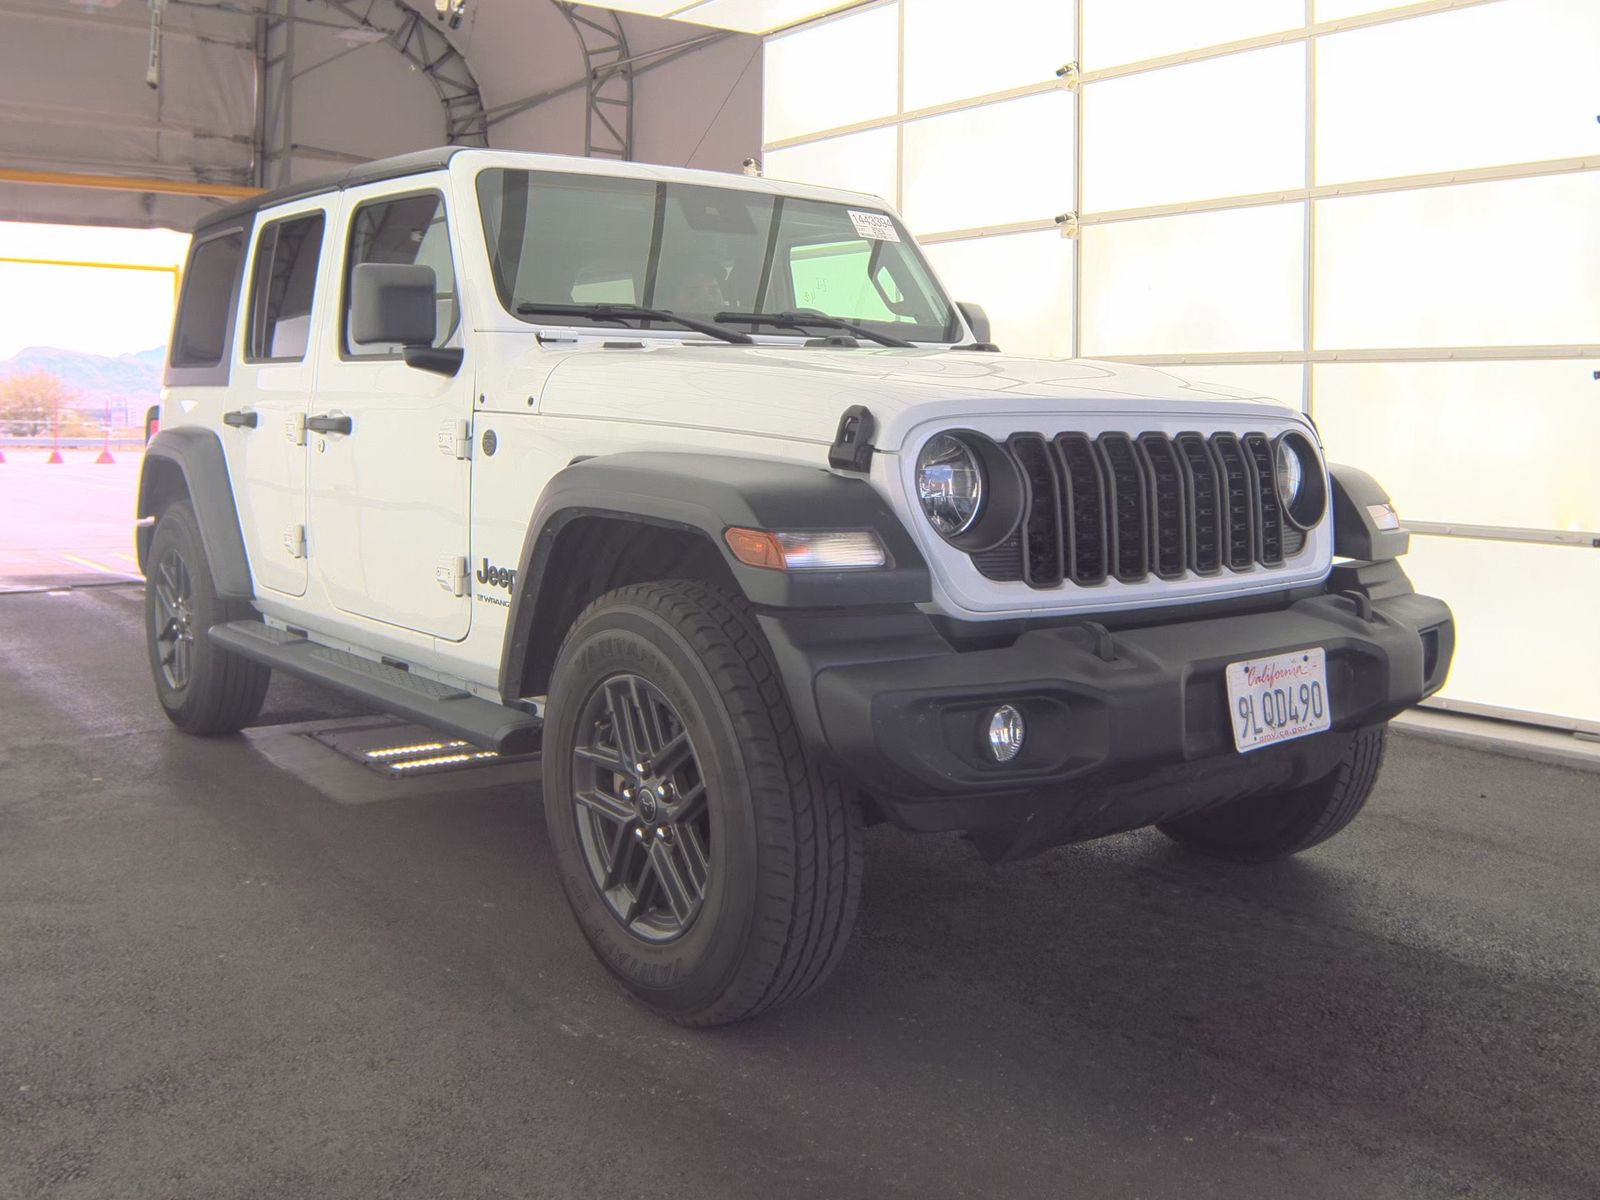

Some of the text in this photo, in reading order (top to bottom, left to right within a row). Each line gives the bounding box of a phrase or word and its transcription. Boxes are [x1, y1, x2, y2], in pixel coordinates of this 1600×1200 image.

[852, 214, 894, 228] 1443394
[477, 558, 517, 595] Jeep
[1247, 664, 1309, 688] California
[1239, 681, 1323, 738] 9LQD490
